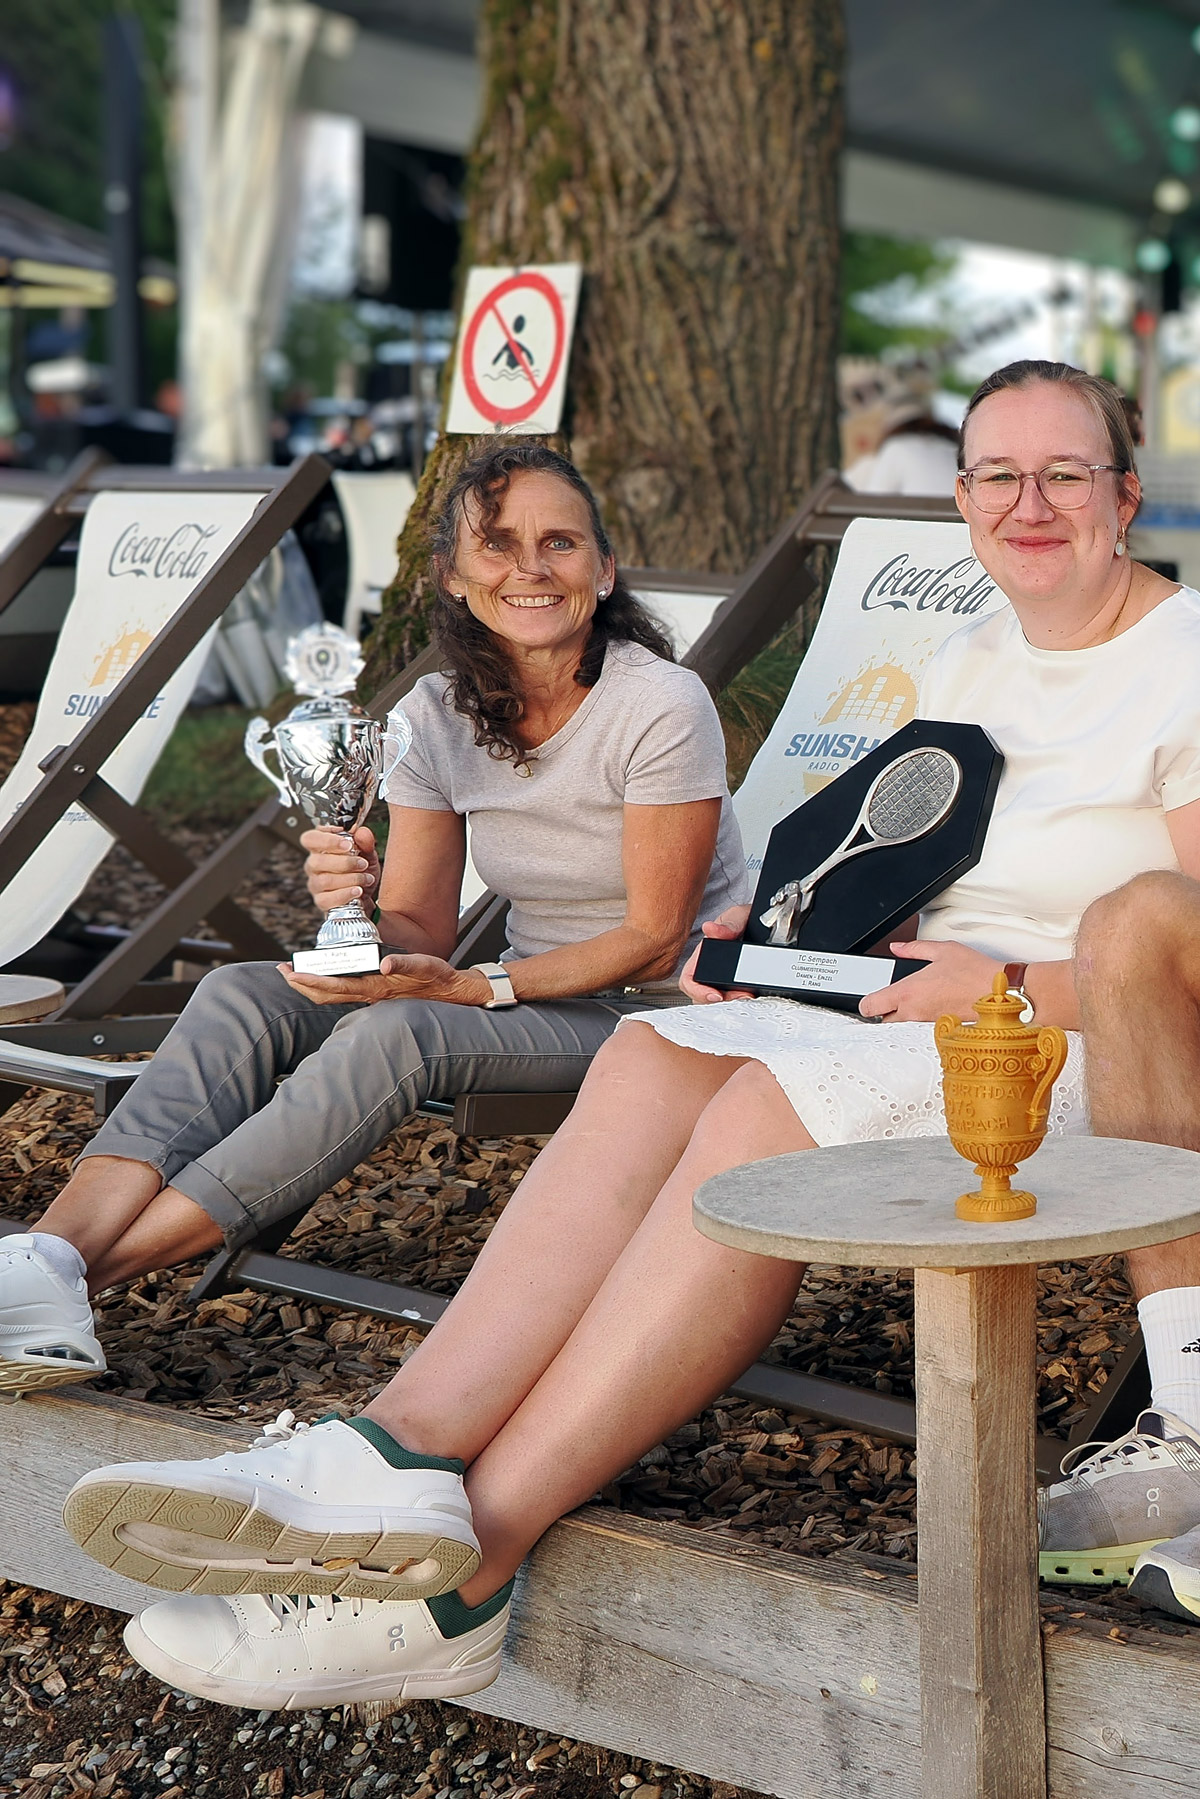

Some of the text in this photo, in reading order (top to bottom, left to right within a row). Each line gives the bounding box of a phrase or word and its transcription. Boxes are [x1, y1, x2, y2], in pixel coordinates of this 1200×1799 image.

[108, 522, 221, 579] Coca-Cola
[861, 553, 997, 616] Coca-Cola
[784, 733, 881, 760] SUNSH
[807, 761, 840, 771] RADIO
[807, 955, 838, 965] Sempach
[951, 1081, 1026, 1100] BIRTHDAY
[947, 1098, 976, 1117] 976
[949, 1115, 1010, 1132] EMPACH
